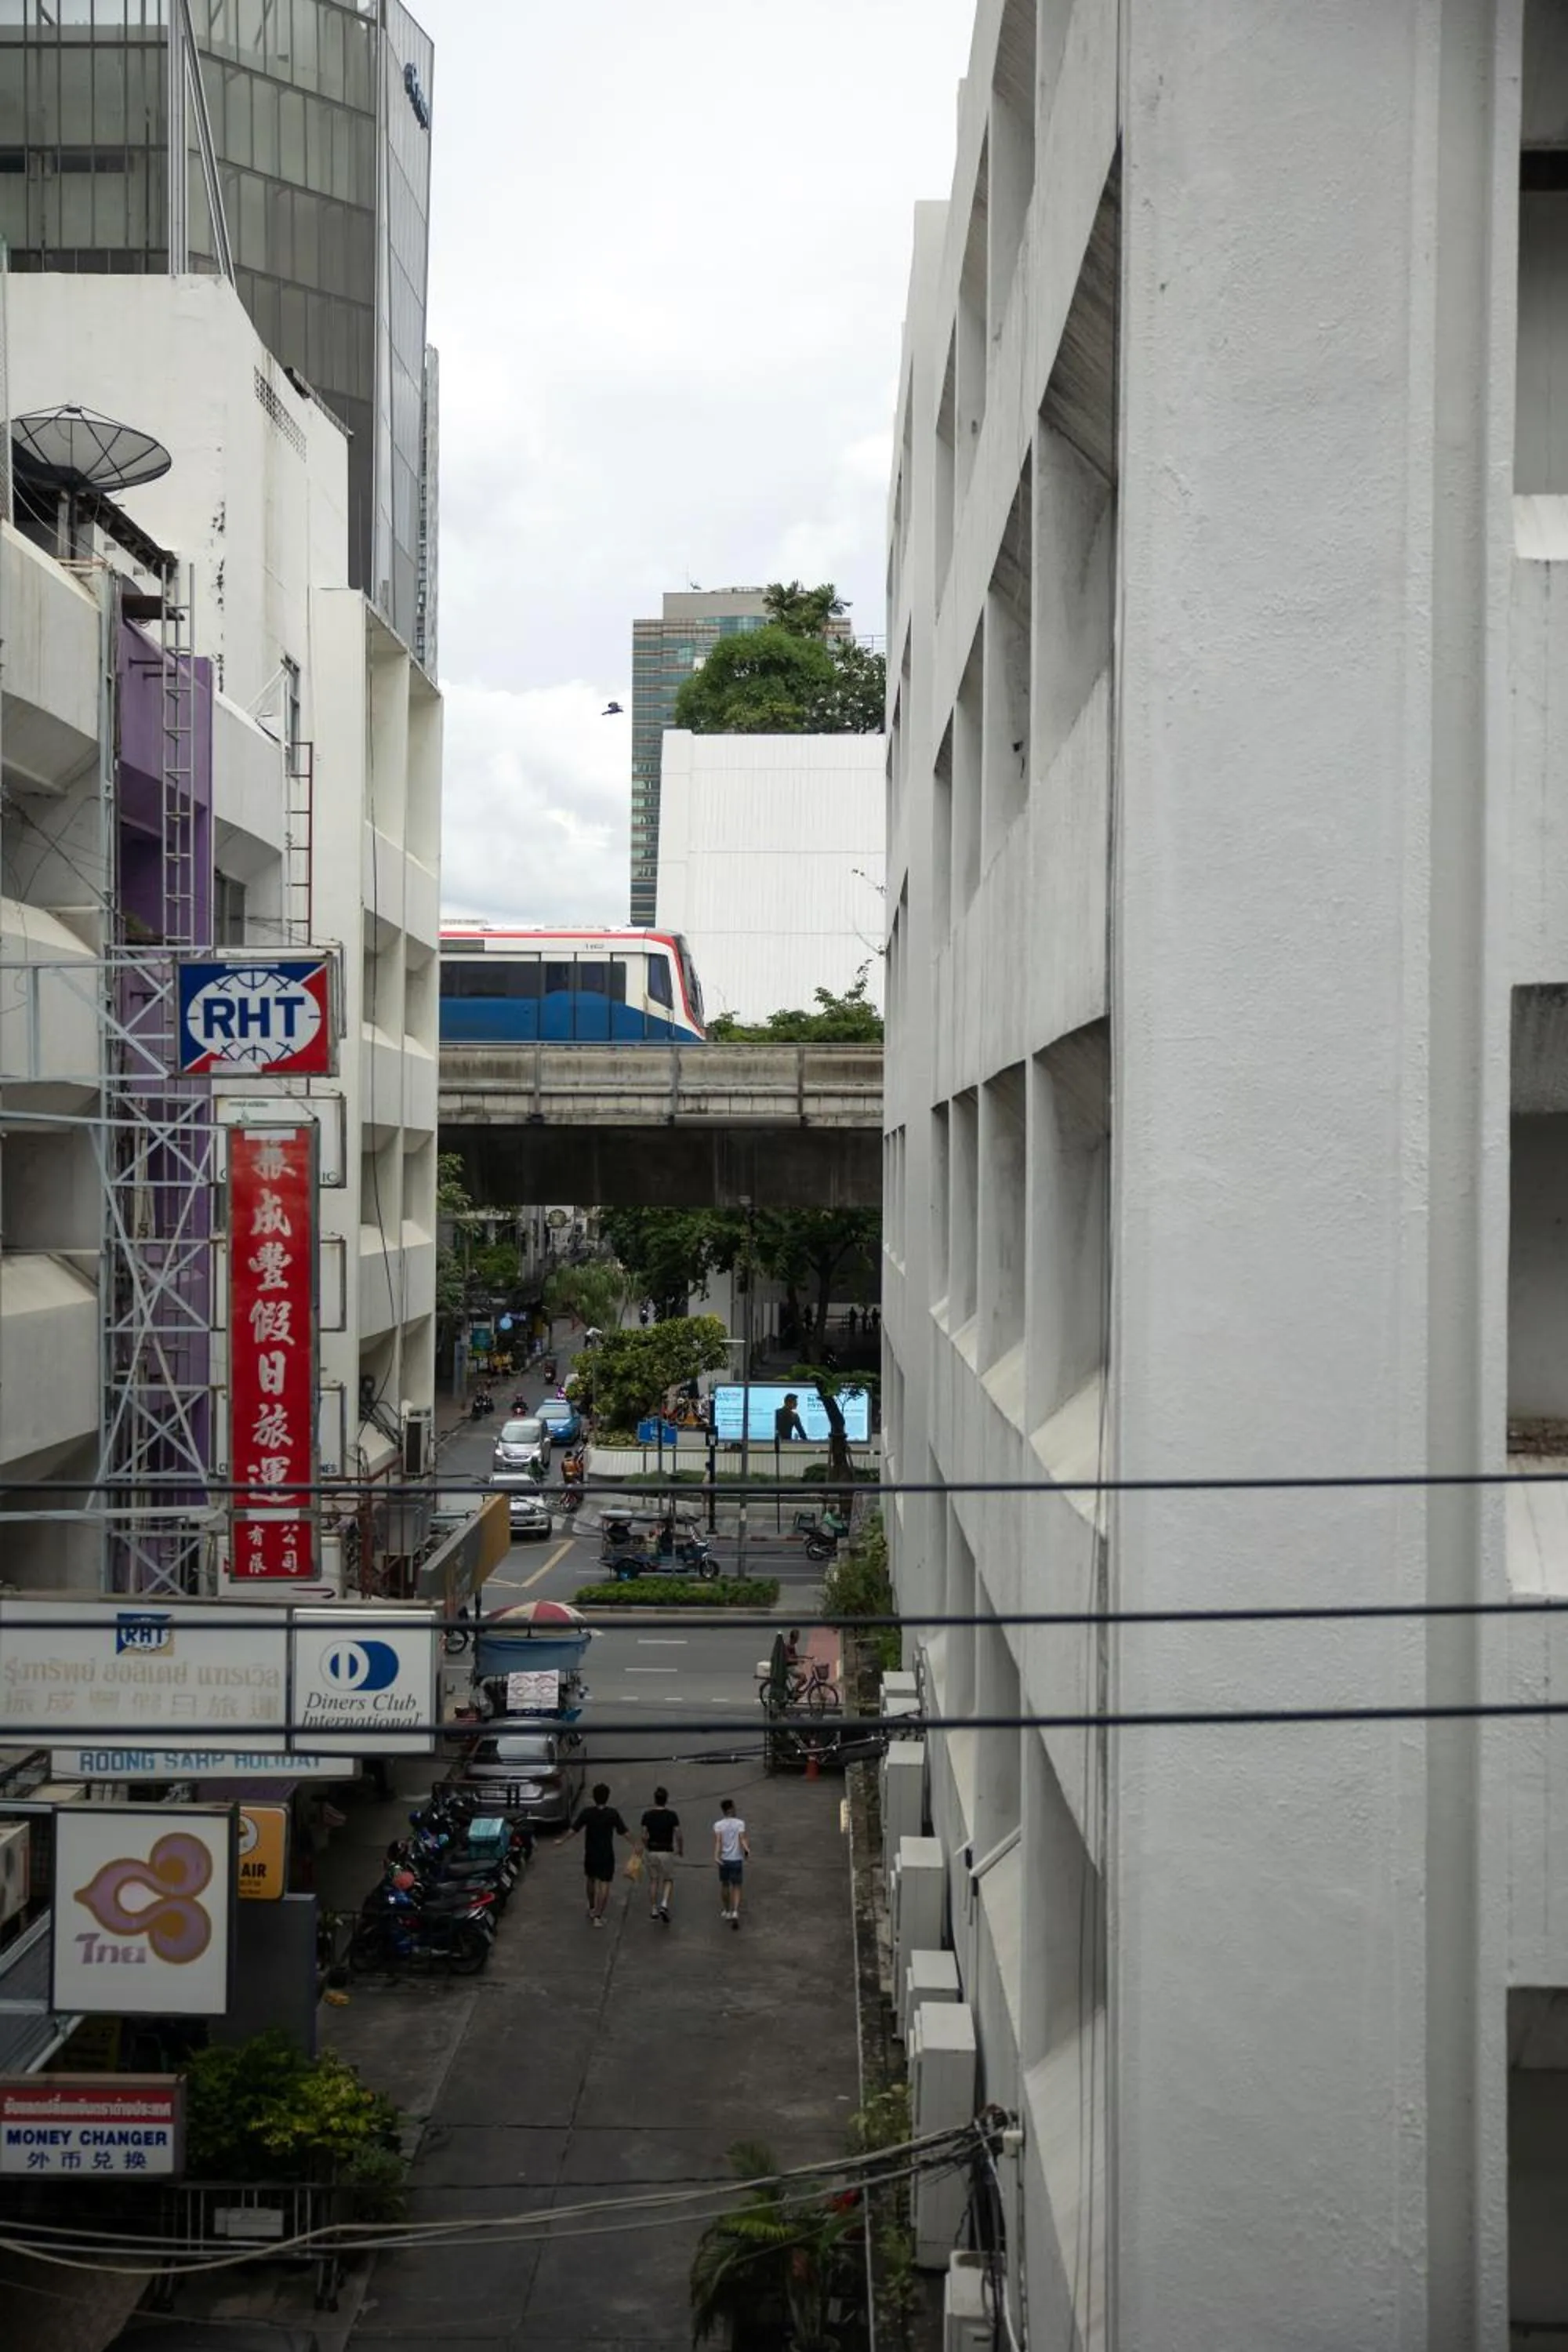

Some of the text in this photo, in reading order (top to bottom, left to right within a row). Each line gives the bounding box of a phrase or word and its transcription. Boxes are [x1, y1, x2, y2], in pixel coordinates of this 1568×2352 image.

[203, 997, 305, 1039] RHT
[306, 1692, 417, 1711] Diners Club
[301, 1710, 420, 1728] International
[79, 1751, 155, 1772] ROONG
[164, 1752, 224, 1770] SARP
[241, 1863, 267, 1879] AIR
[6, 2129, 168, 2147] MONEY CHANGER
